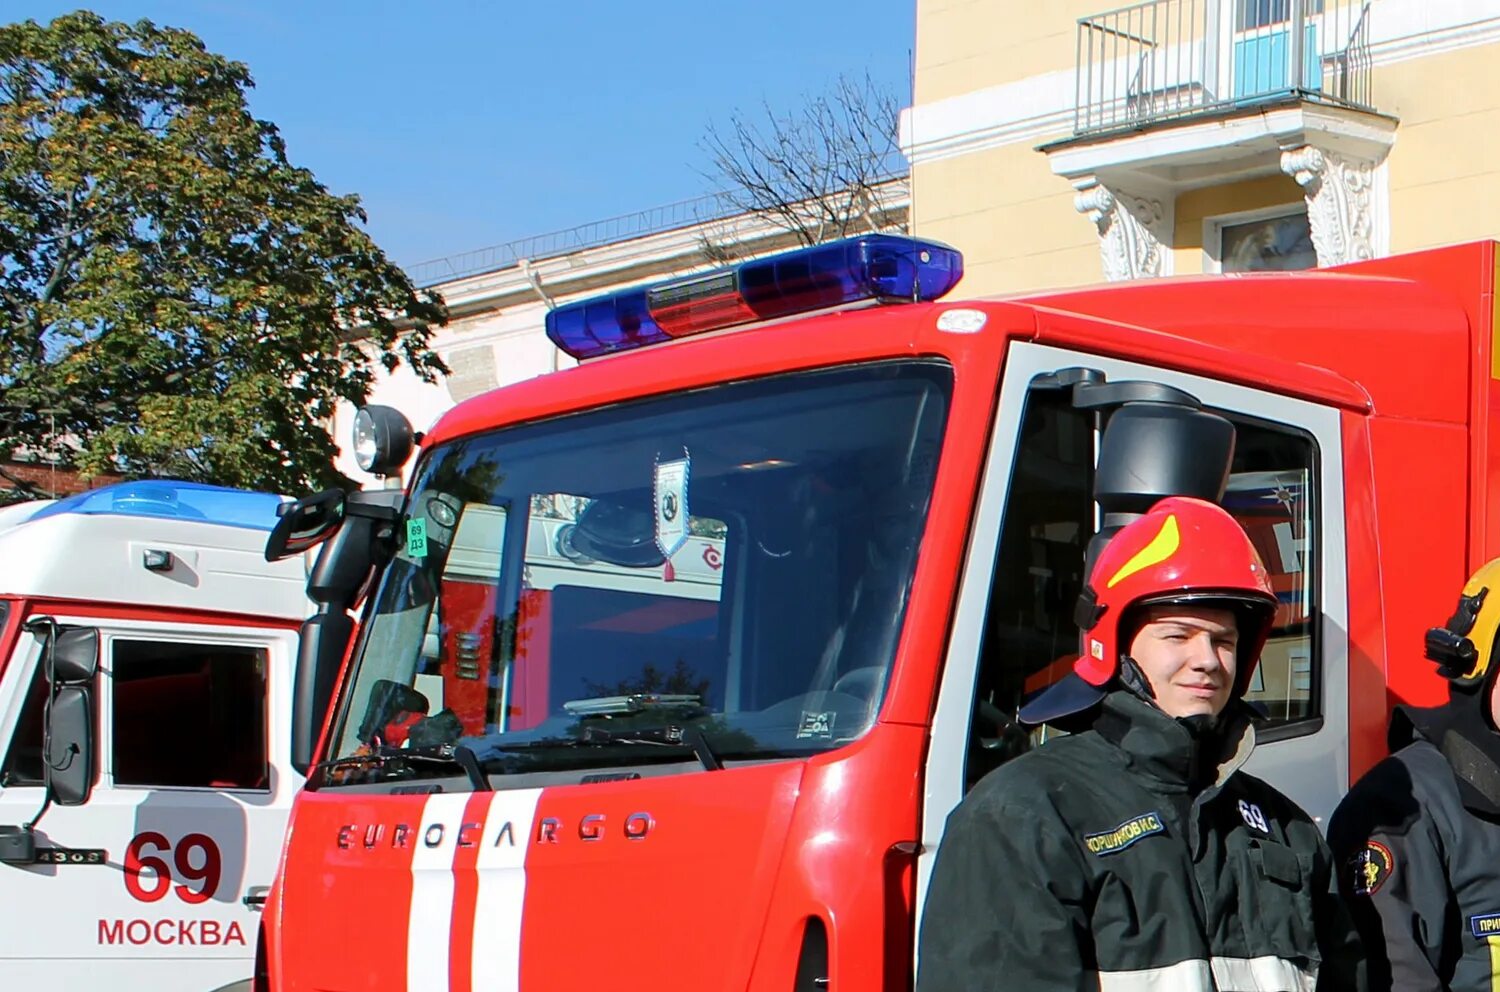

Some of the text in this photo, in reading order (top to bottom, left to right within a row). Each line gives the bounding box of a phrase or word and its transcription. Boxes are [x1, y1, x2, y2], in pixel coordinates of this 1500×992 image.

[411, 525, 422, 536] 69
[337, 812, 653, 849] EUROCARGO
[1238, 800, 1268, 833] 69
[124, 832, 221, 904] 69
[98, 920, 247, 946] МОСКВА
